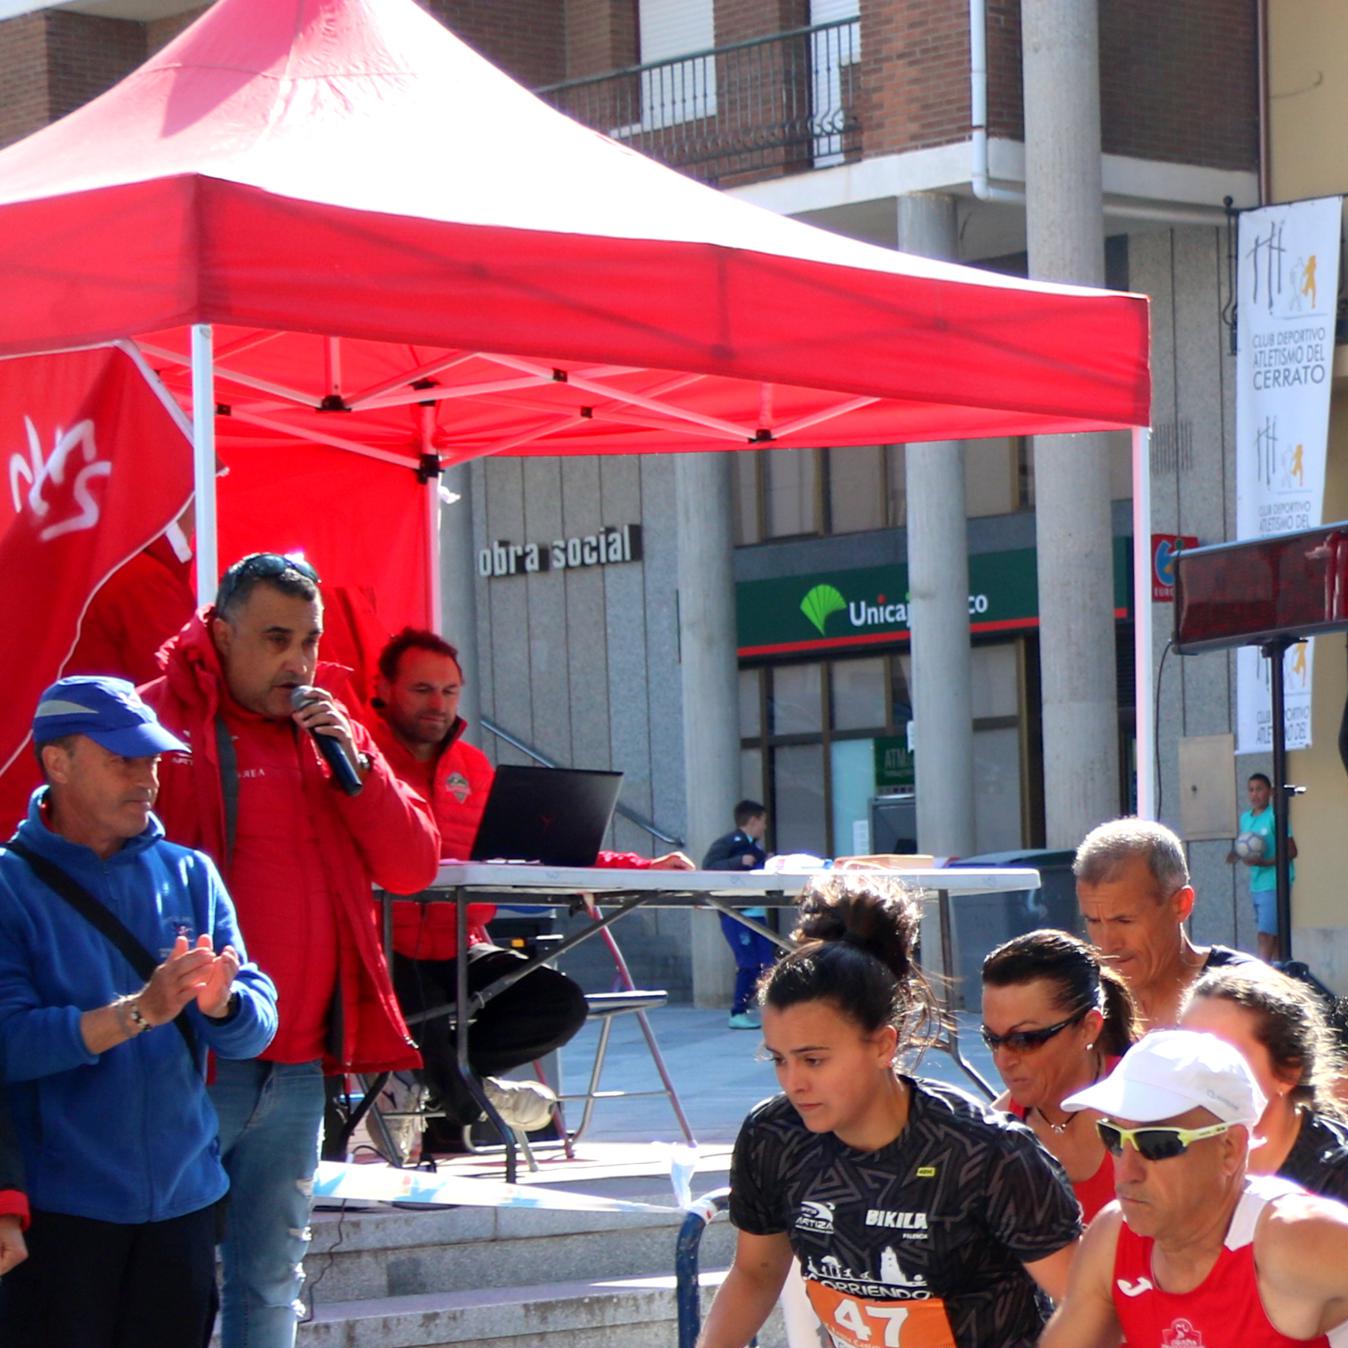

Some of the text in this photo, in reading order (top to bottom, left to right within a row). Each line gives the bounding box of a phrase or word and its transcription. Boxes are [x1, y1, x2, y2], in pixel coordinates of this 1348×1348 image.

[1252, 327, 1326, 349] CLUB DEPORTIVO
[1252, 343, 1326, 370] ATLETISMO DEL
[1252, 364, 1326, 391] CERRATO
[1295, 514, 1311, 530] DEL
[479, 524, 631, 577] obra social
[865, 1209, 929, 1230] BIKILA
[834, 1298, 909, 1348] 47
